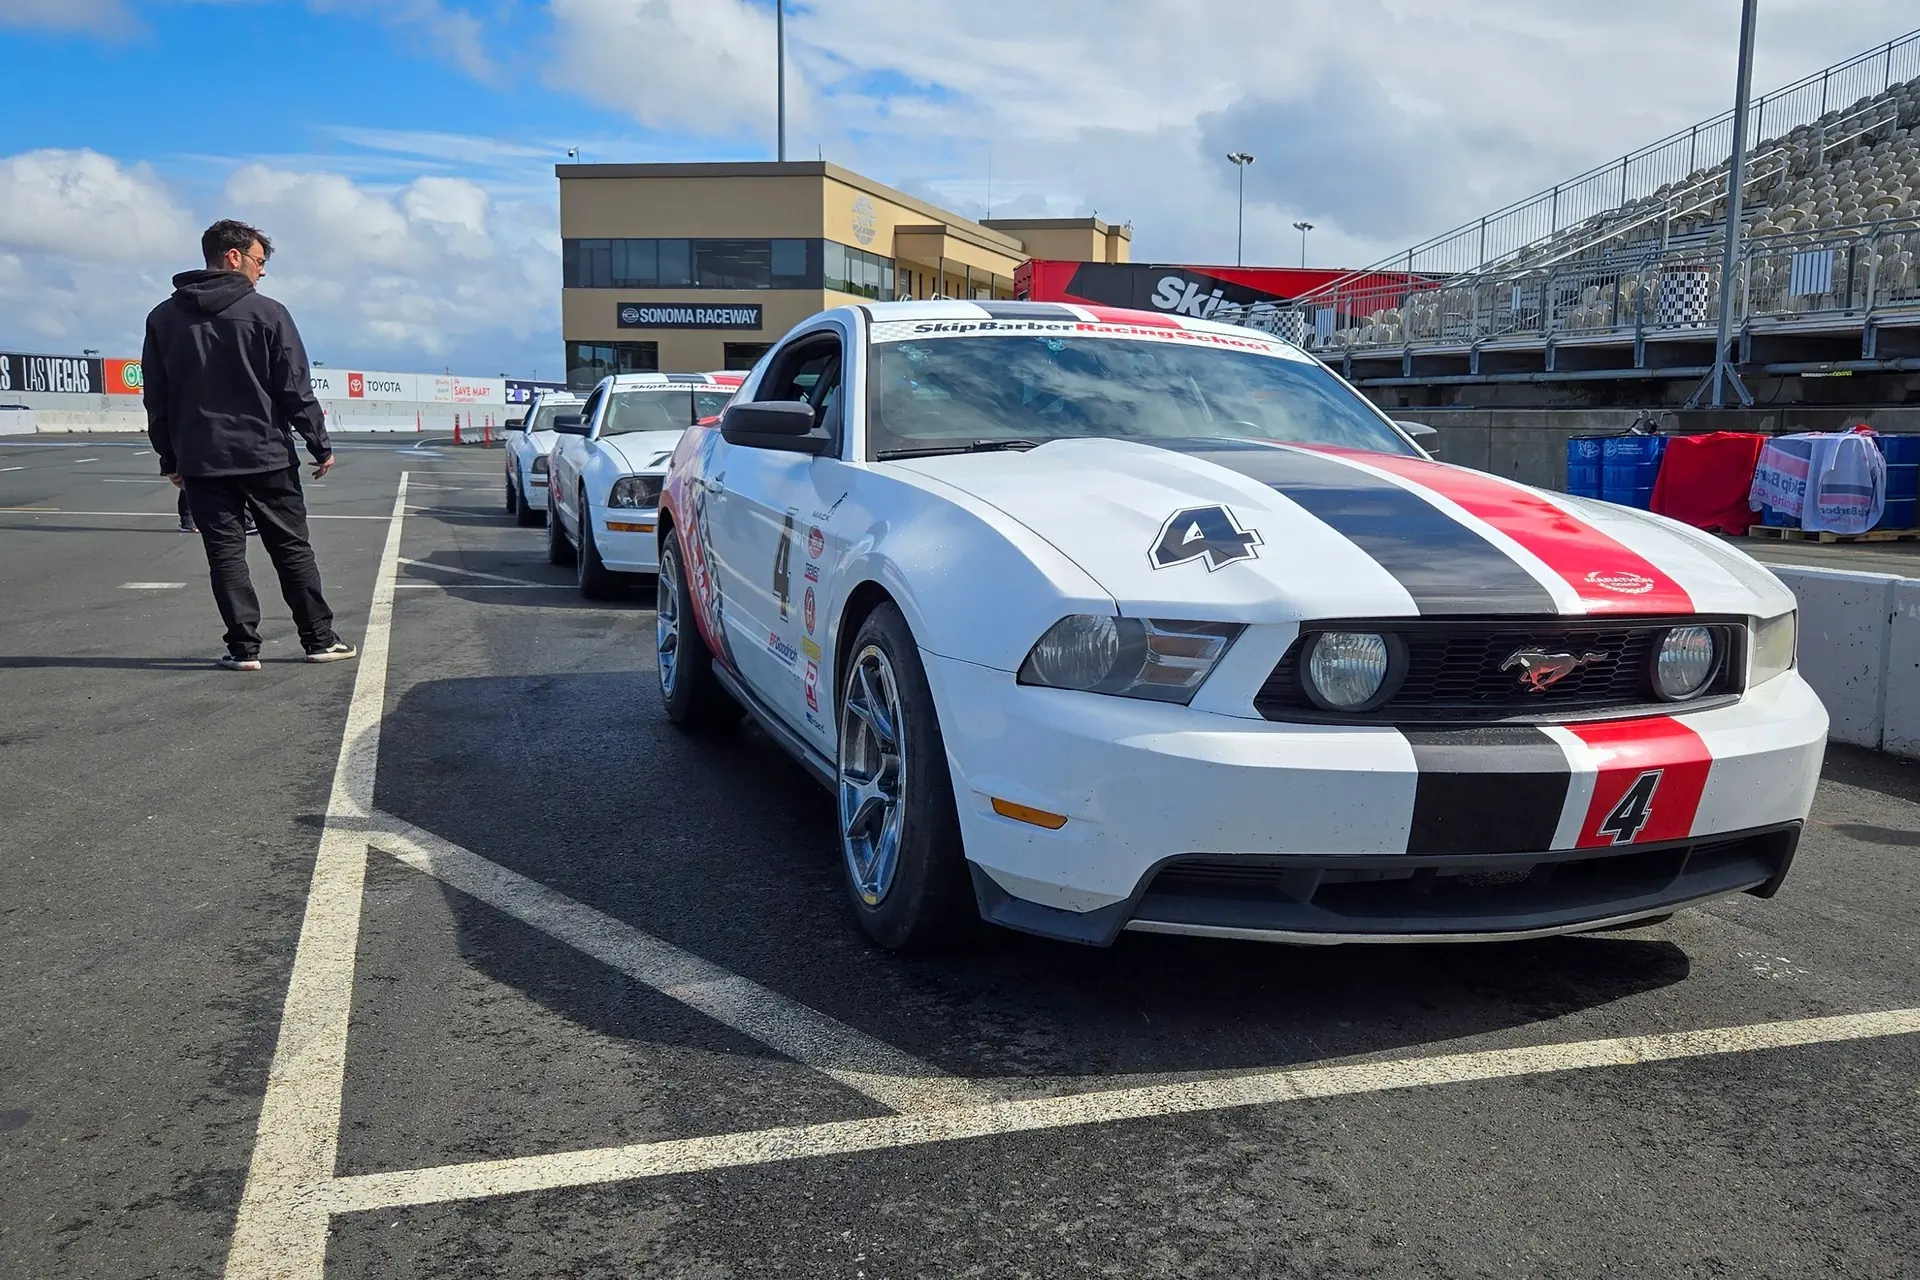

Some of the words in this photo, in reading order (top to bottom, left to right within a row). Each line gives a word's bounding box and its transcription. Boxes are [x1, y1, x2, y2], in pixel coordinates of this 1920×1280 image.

[640, 308, 694, 323] SONOMA
[696, 309, 757, 324] RACEWAY
[22, 357, 45, 391] LAS
[46, 358, 90, 392] VEGAS
[367, 381, 401, 392] TOYOTA
[454, 386, 471, 396] SAVE
[472, 388, 490, 397] MART
[1146, 504, 1265, 573] 4
[773, 507, 798, 623] 4
[1596, 769, 1664, 846] 4
